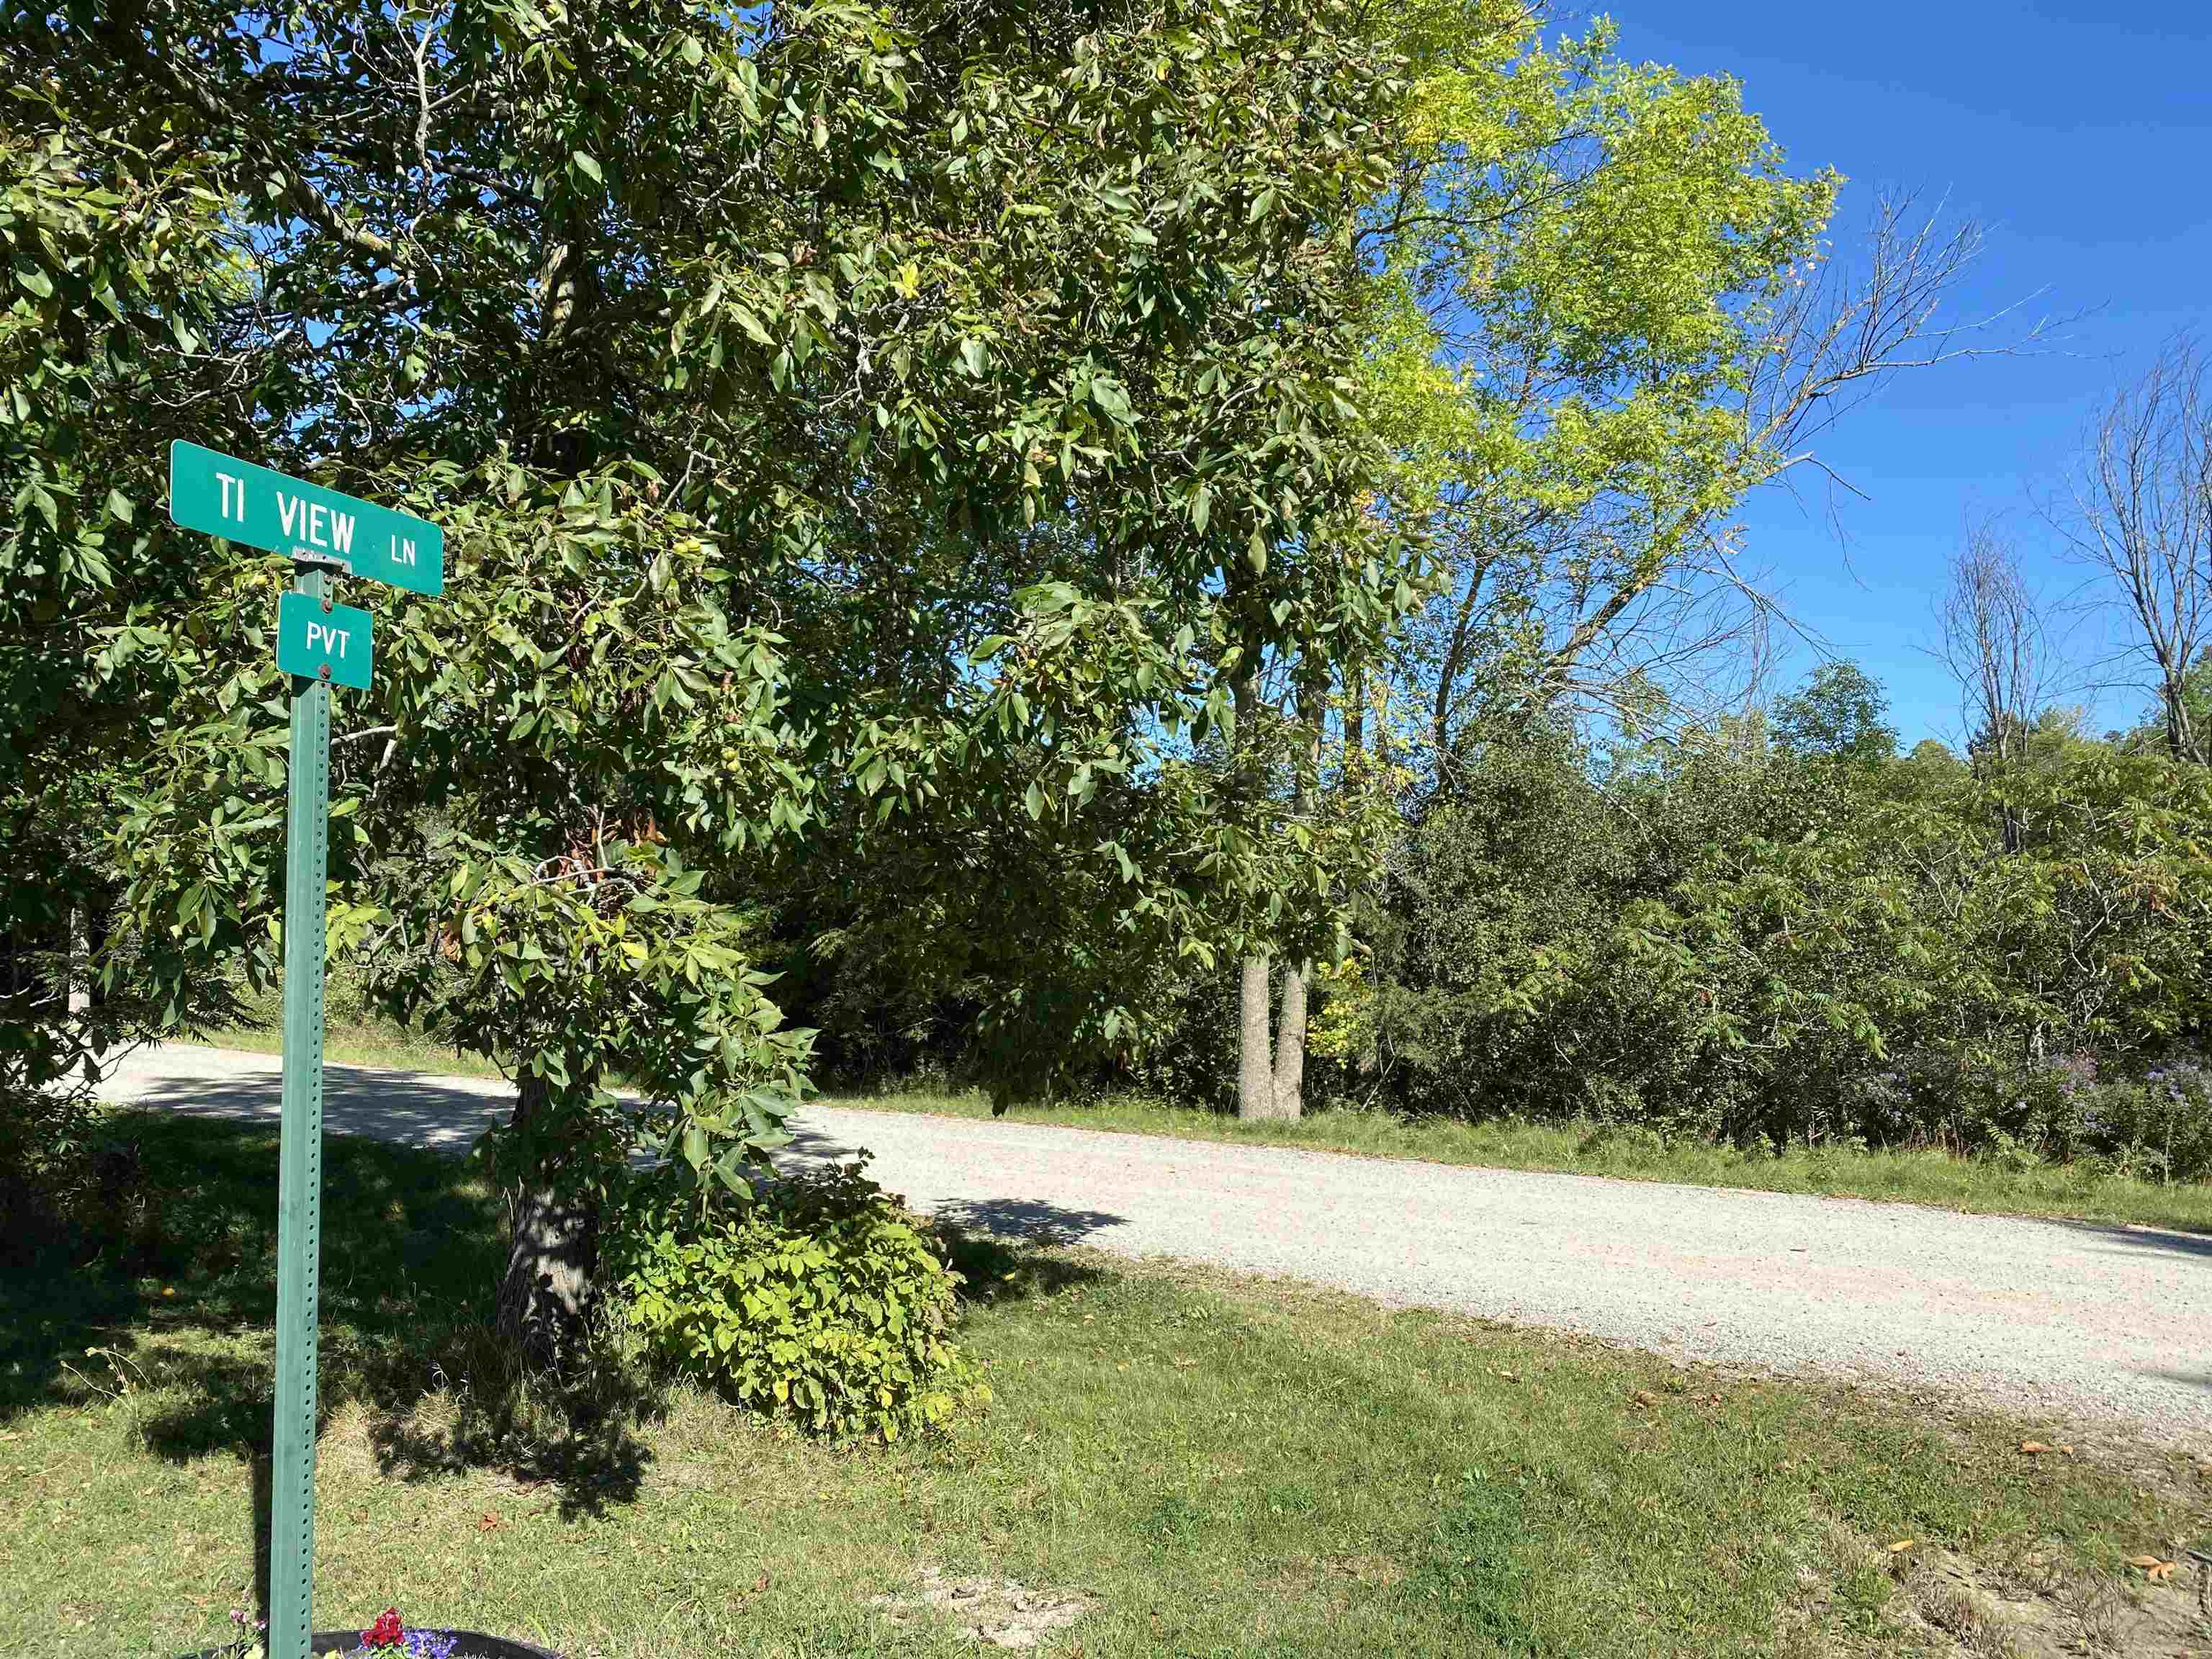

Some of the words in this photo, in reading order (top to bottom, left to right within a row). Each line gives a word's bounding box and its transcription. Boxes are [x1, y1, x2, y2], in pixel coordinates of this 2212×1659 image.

[216, 472, 244, 523] TI
[276, 491, 355, 553] VIEW
[391, 534, 415, 566] LN
[306, 621, 350, 658] PVT
